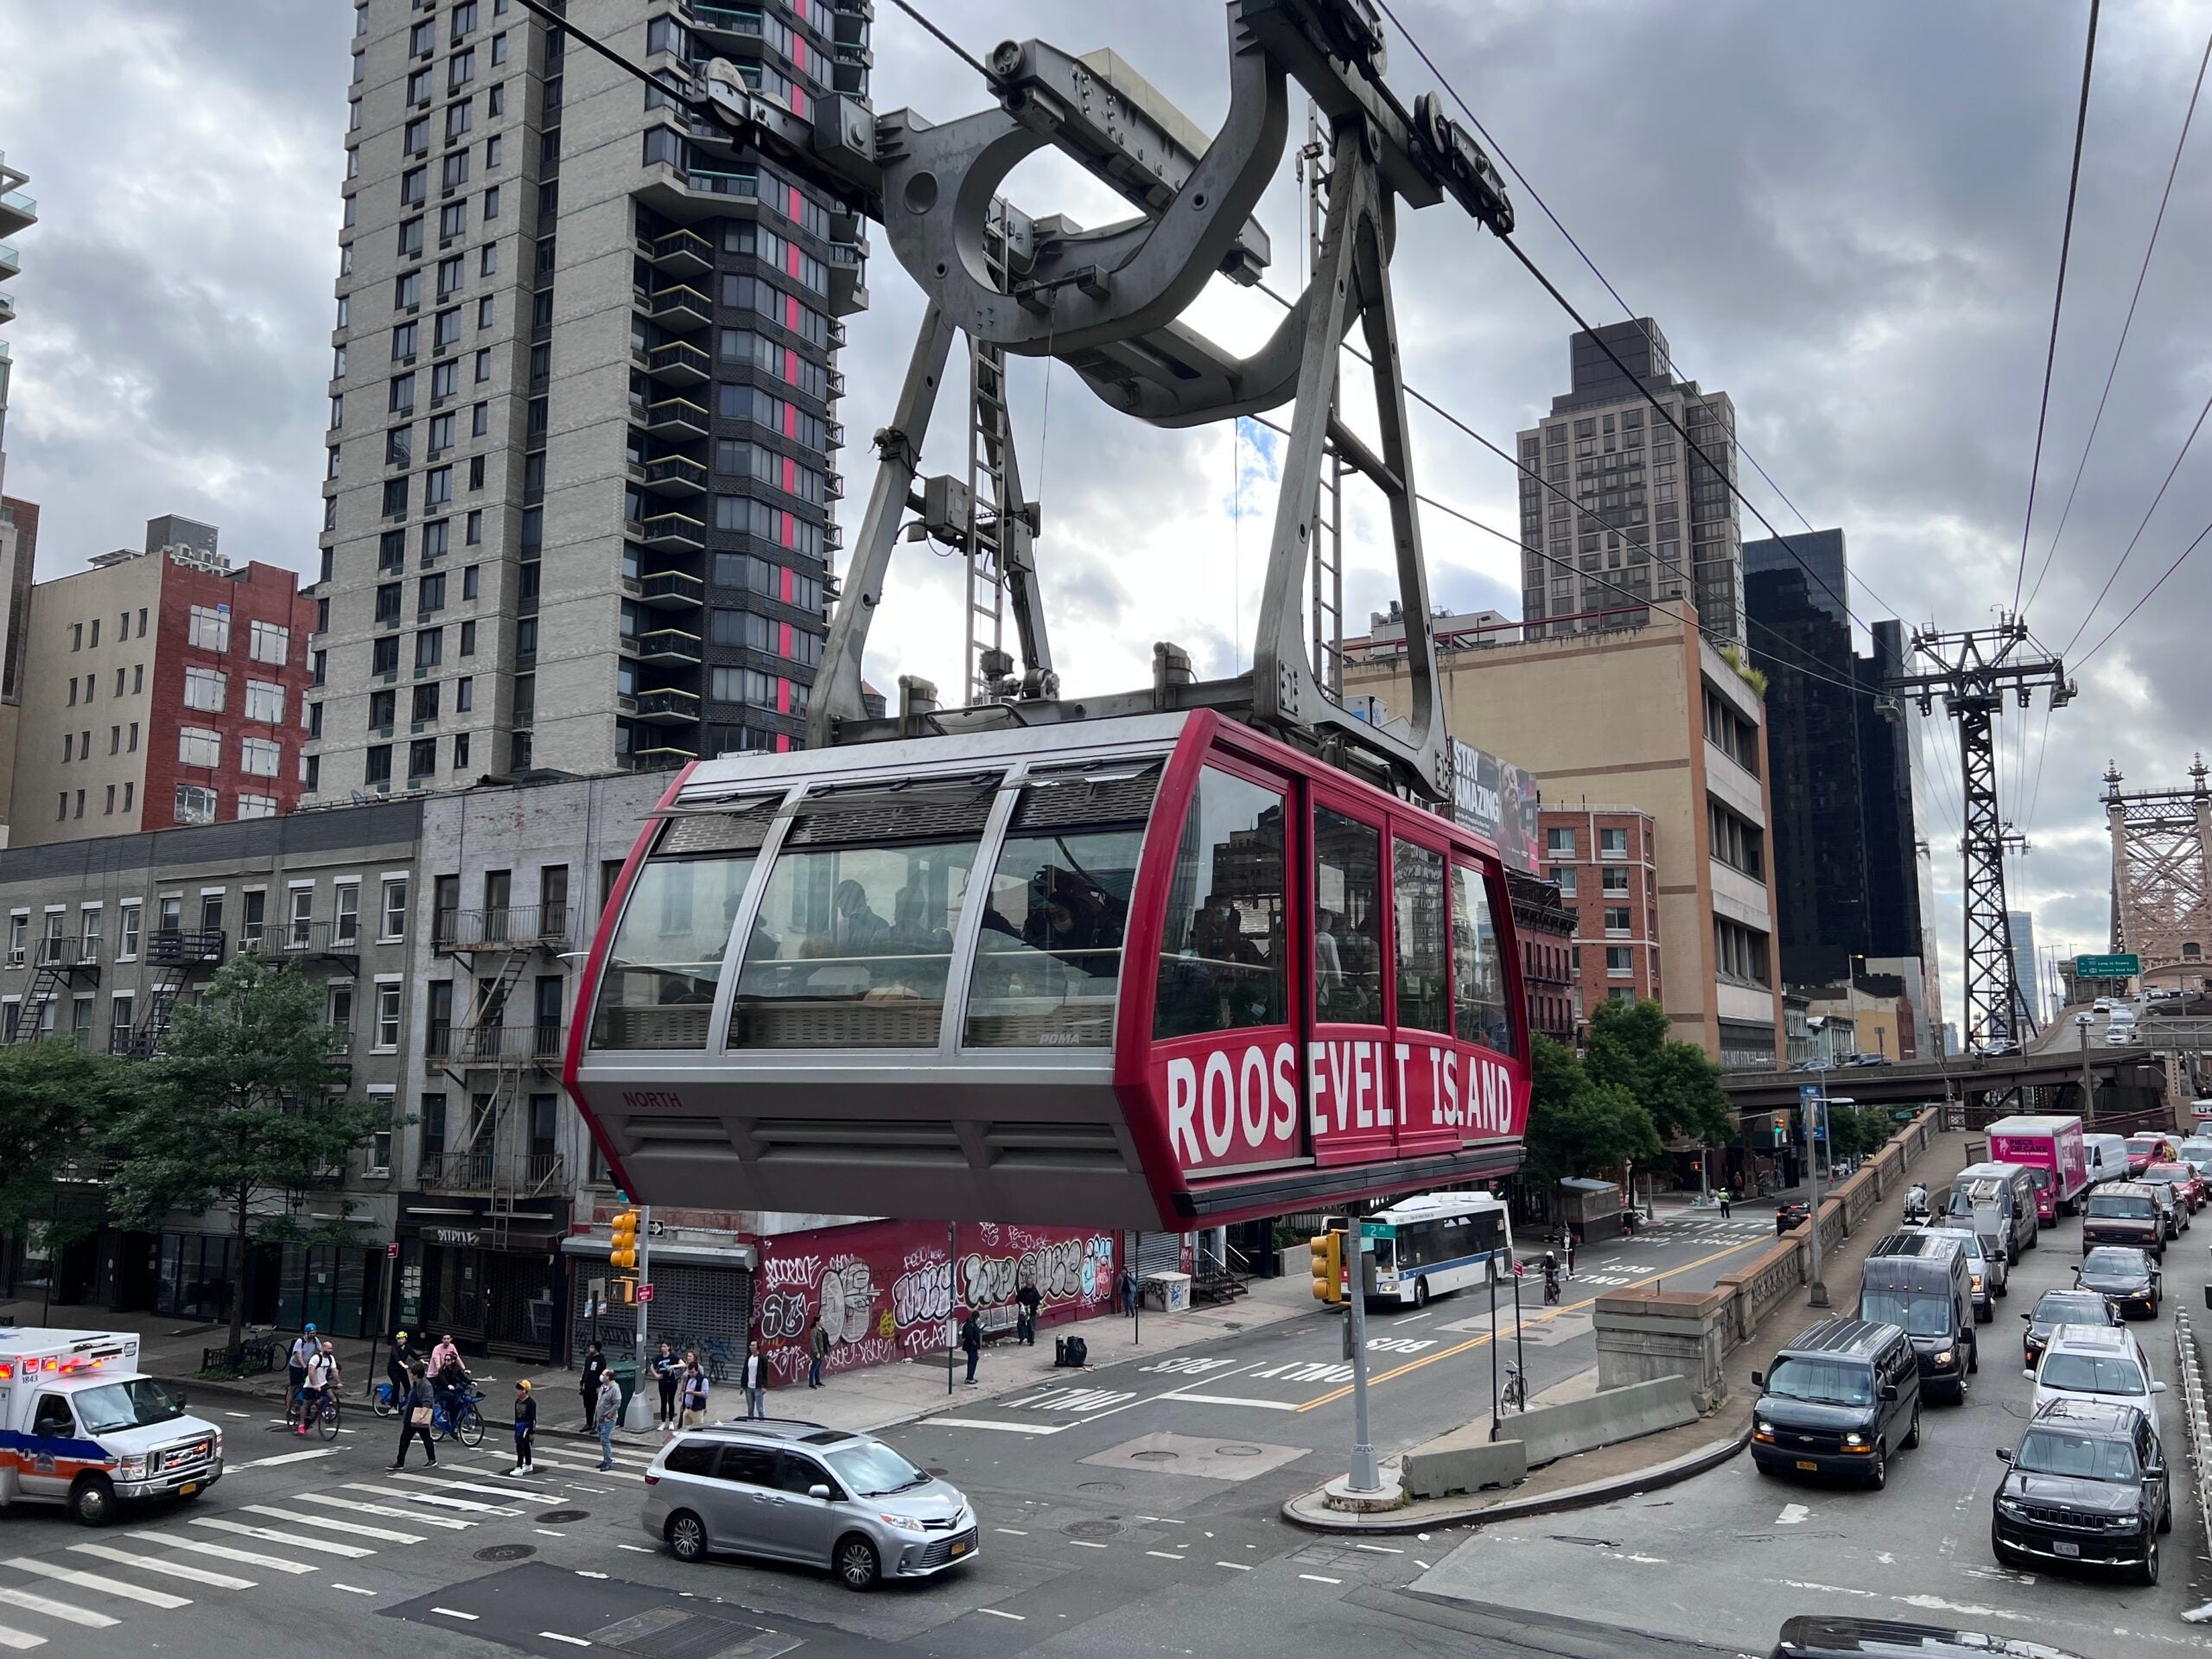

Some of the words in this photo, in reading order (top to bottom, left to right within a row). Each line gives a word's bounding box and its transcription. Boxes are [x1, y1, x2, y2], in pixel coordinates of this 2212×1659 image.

[1453, 741, 1478, 781] STAY
[1454, 775, 1499, 823] AMAZING
[1039, 1033, 1080, 1044] POMA
[622, 1091, 683, 1107] NORTH
[1167, 1040, 1410, 1165] ROOSEVELT
[1370, 1225, 1376, 1236] 2
[1601, 1264, 1657, 1274] BUS
[1365, 1337, 1438, 1354] BUS
[1138, 1357, 1237, 1375] BUS
[1249, 1362, 1370, 1382] ONLY
[22, 1375, 38, 1384] 1843
[997, 1388, 1137, 1411] ONLY
